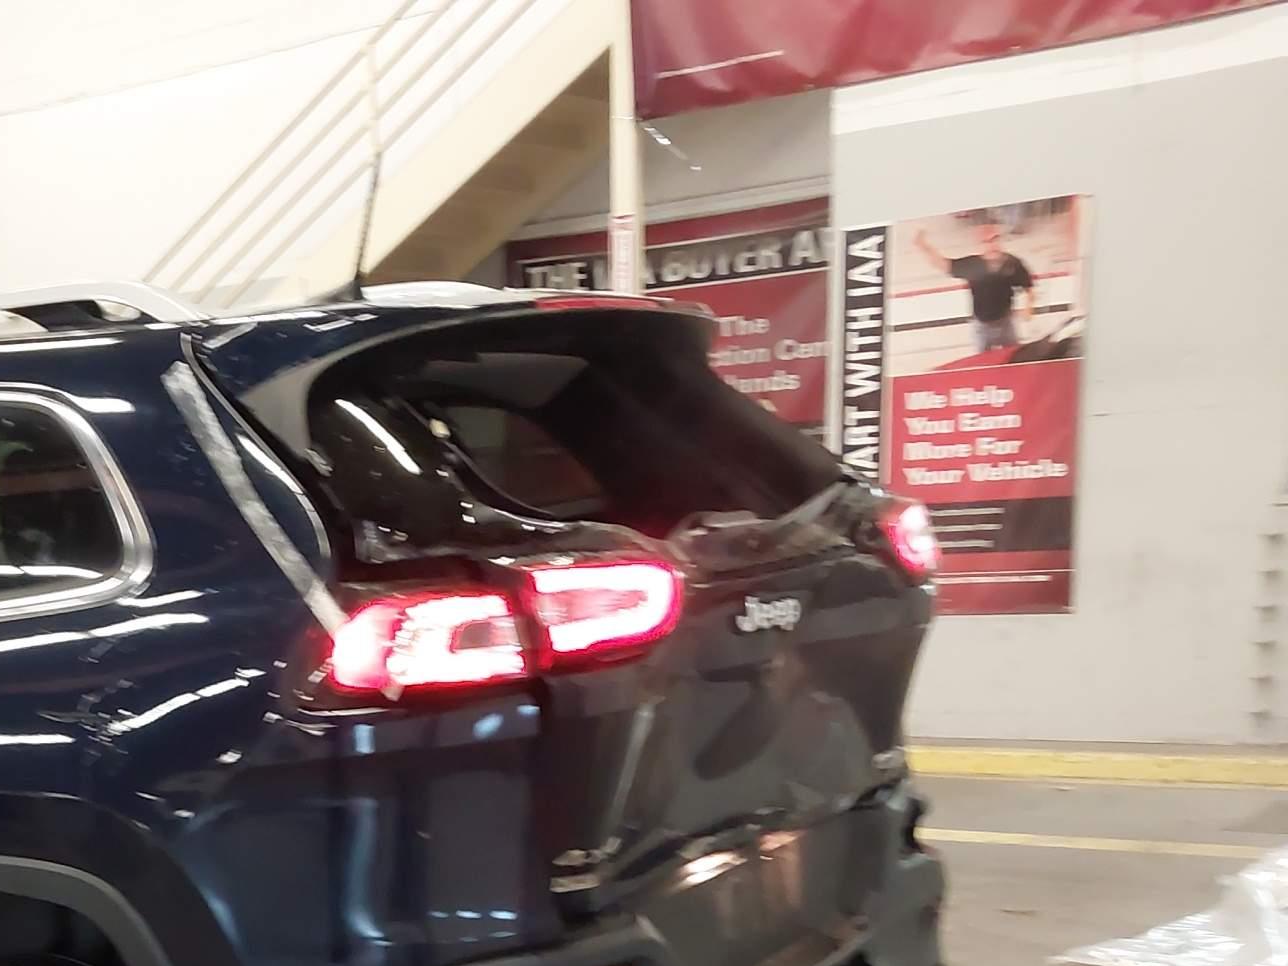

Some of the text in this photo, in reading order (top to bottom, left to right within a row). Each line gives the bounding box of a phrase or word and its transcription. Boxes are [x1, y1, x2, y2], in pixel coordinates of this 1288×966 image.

[524, 262, 587, 290] THE
[847, 234, 885, 297] IAA
[845, 306, 883, 398] WITH
[903, 385, 1014, 410] We Help
[903, 413, 1022, 435] You Earn
[903, 437, 1025, 460] More For
[902, 459, 1069, 485] Your Vehicle
[735, 595, 801, 632] Jeep
